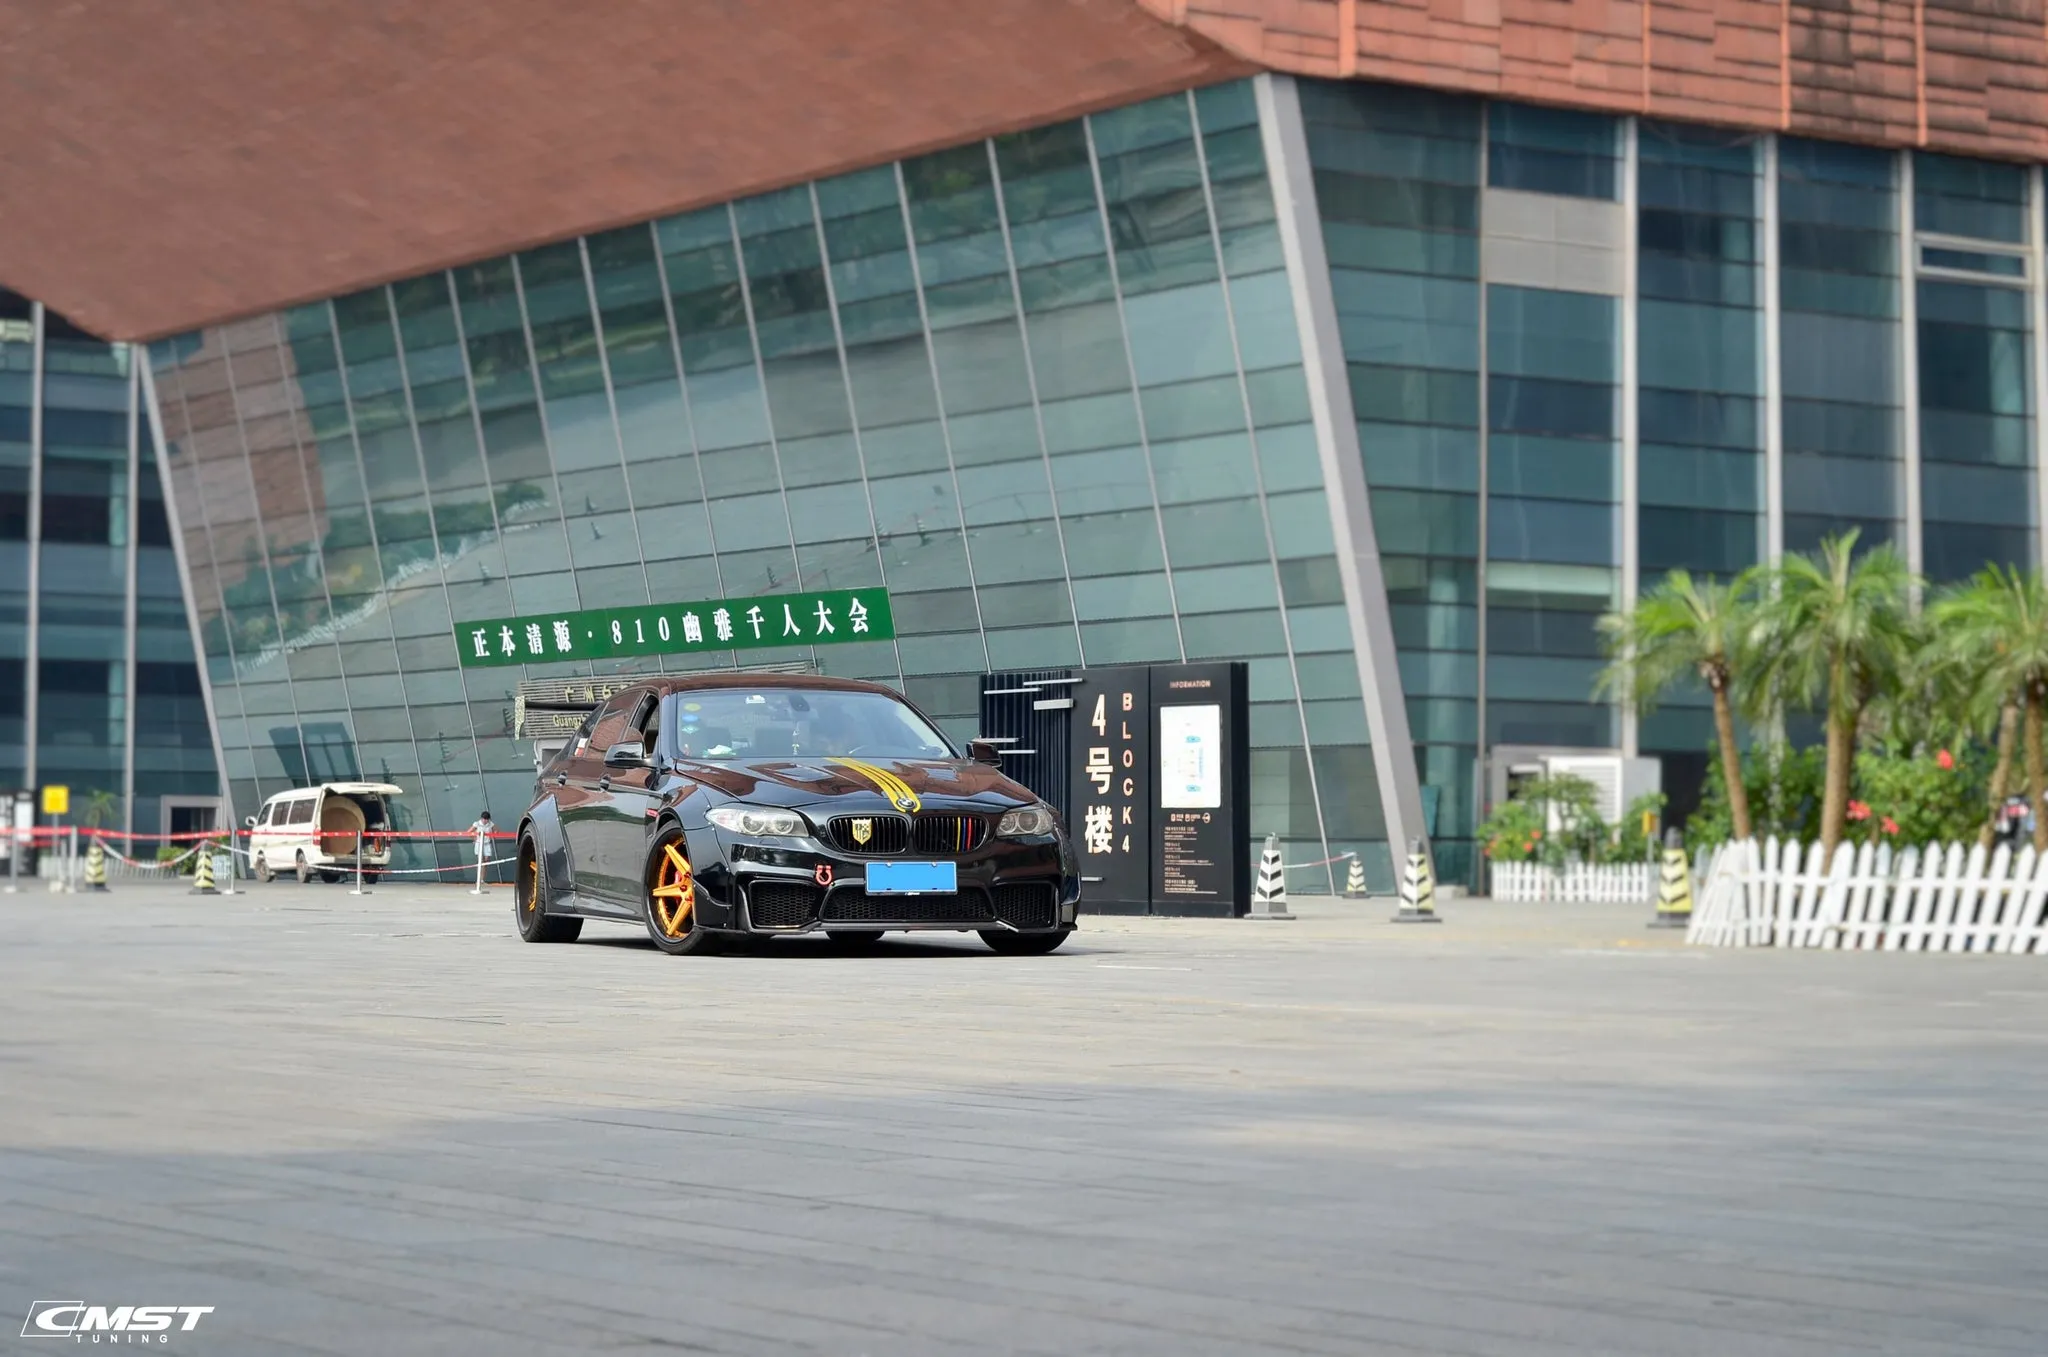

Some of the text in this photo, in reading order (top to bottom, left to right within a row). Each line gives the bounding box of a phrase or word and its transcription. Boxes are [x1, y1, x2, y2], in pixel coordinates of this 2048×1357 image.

[564, 683, 628, 703] 广州白
[1169, 679, 1211, 689] INFORMATION
[1084, 693, 1114, 854] 4号楼
[1121, 692, 1134, 853] BLOCK 4
